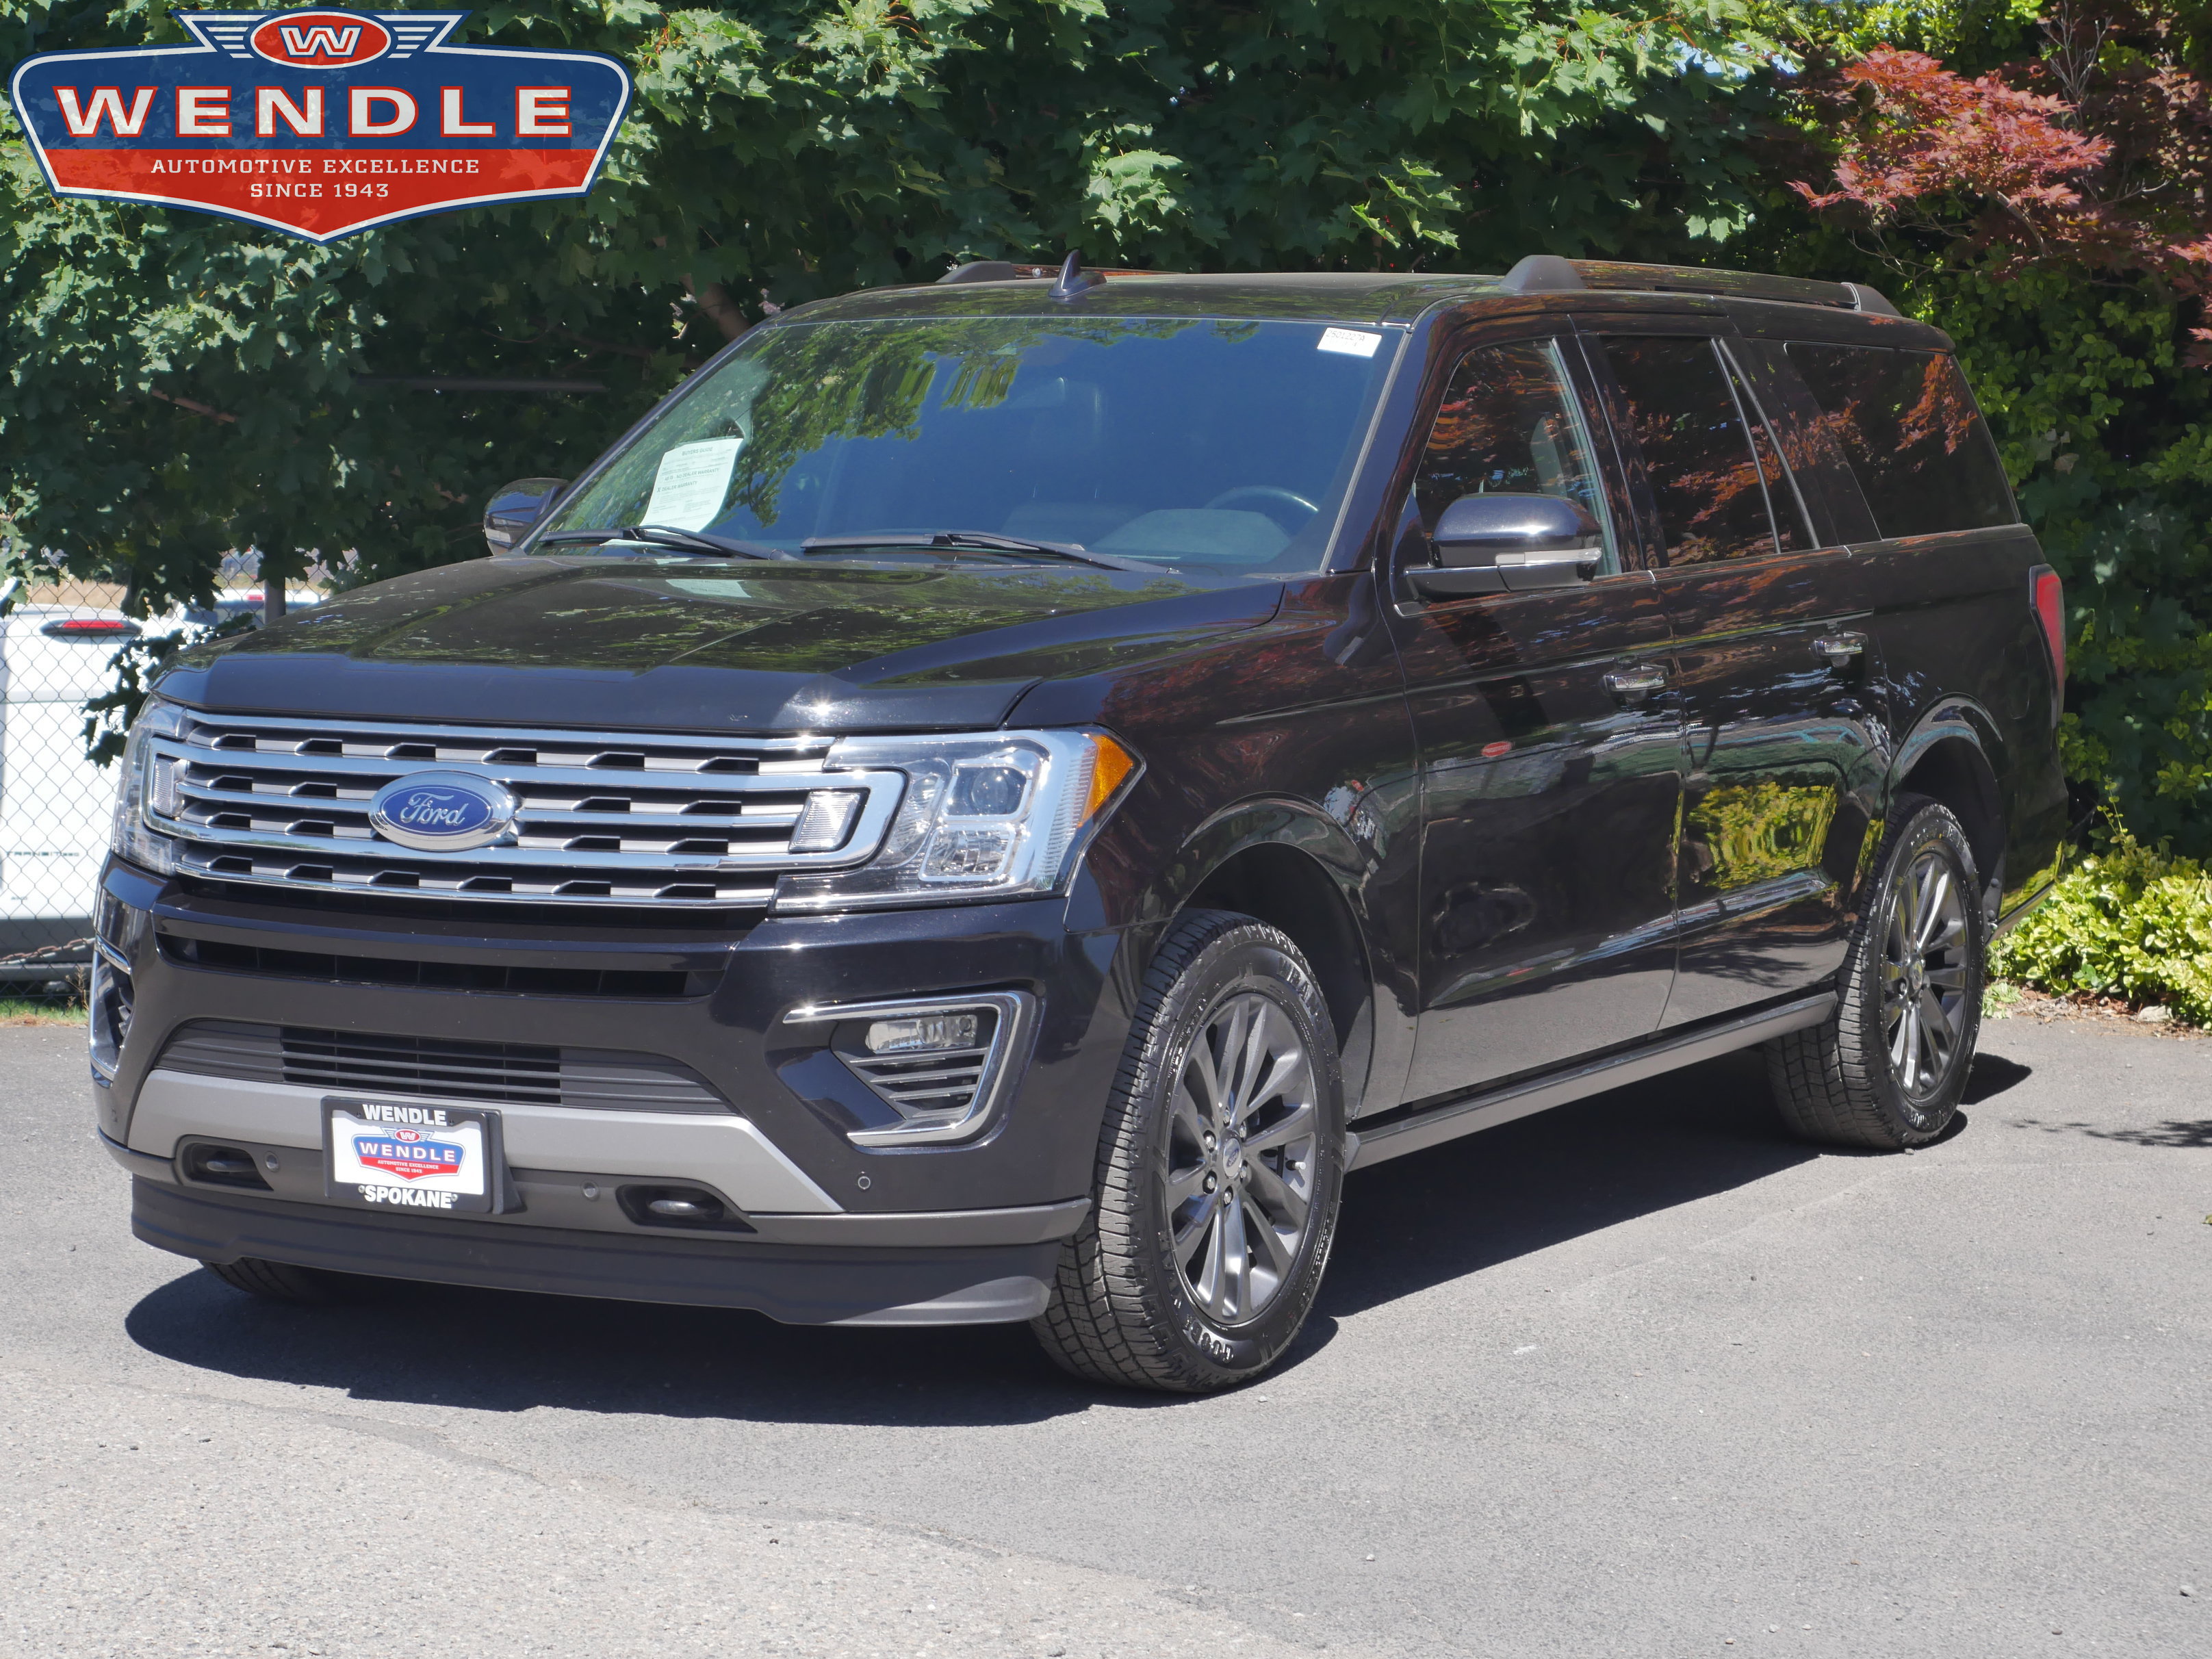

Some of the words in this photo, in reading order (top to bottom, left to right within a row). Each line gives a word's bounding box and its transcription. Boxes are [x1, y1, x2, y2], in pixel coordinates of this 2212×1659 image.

[677, 480, 697, 489] WARRANTY
[400, 792, 470, 826] Ford
[362, 1104, 447, 1127] WENDLE
[359, 1142, 455, 1162] WENDLE
[365, 1185, 452, 1209] SPOKANE
